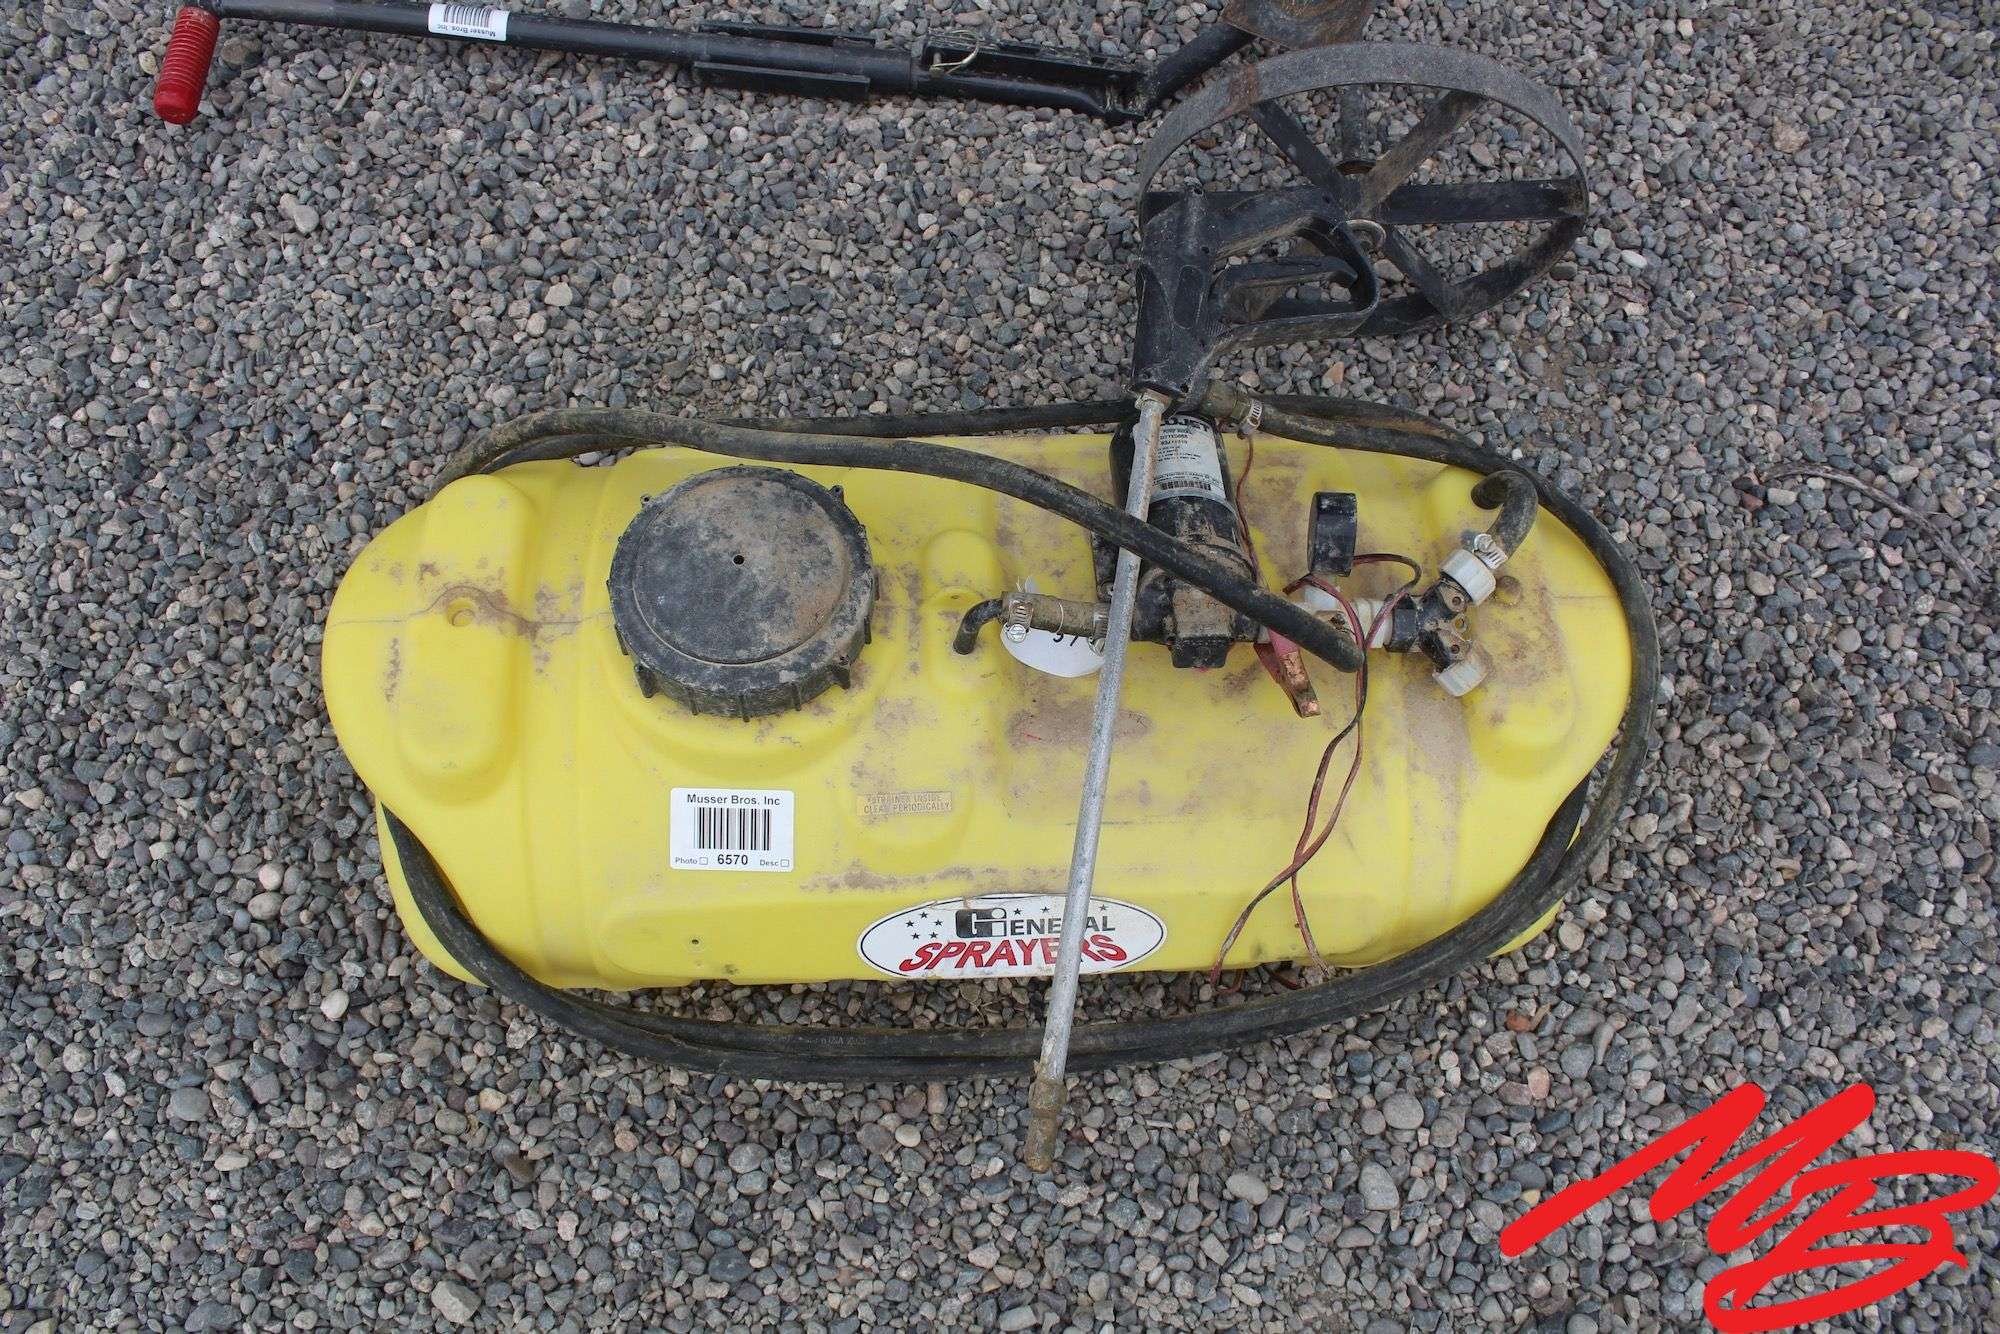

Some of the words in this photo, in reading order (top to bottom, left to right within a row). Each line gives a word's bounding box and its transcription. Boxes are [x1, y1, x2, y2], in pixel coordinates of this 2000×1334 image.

[686, 793, 728, 804] Musser
[731, 794, 760, 805] Bros.
[763, 795, 781, 806] Inc
[675, 856, 698, 865] Photo
[717, 854, 749, 866] 6570
[759, 858, 779, 867] Desc
[955, 907, 1116, 939] GENEAL
